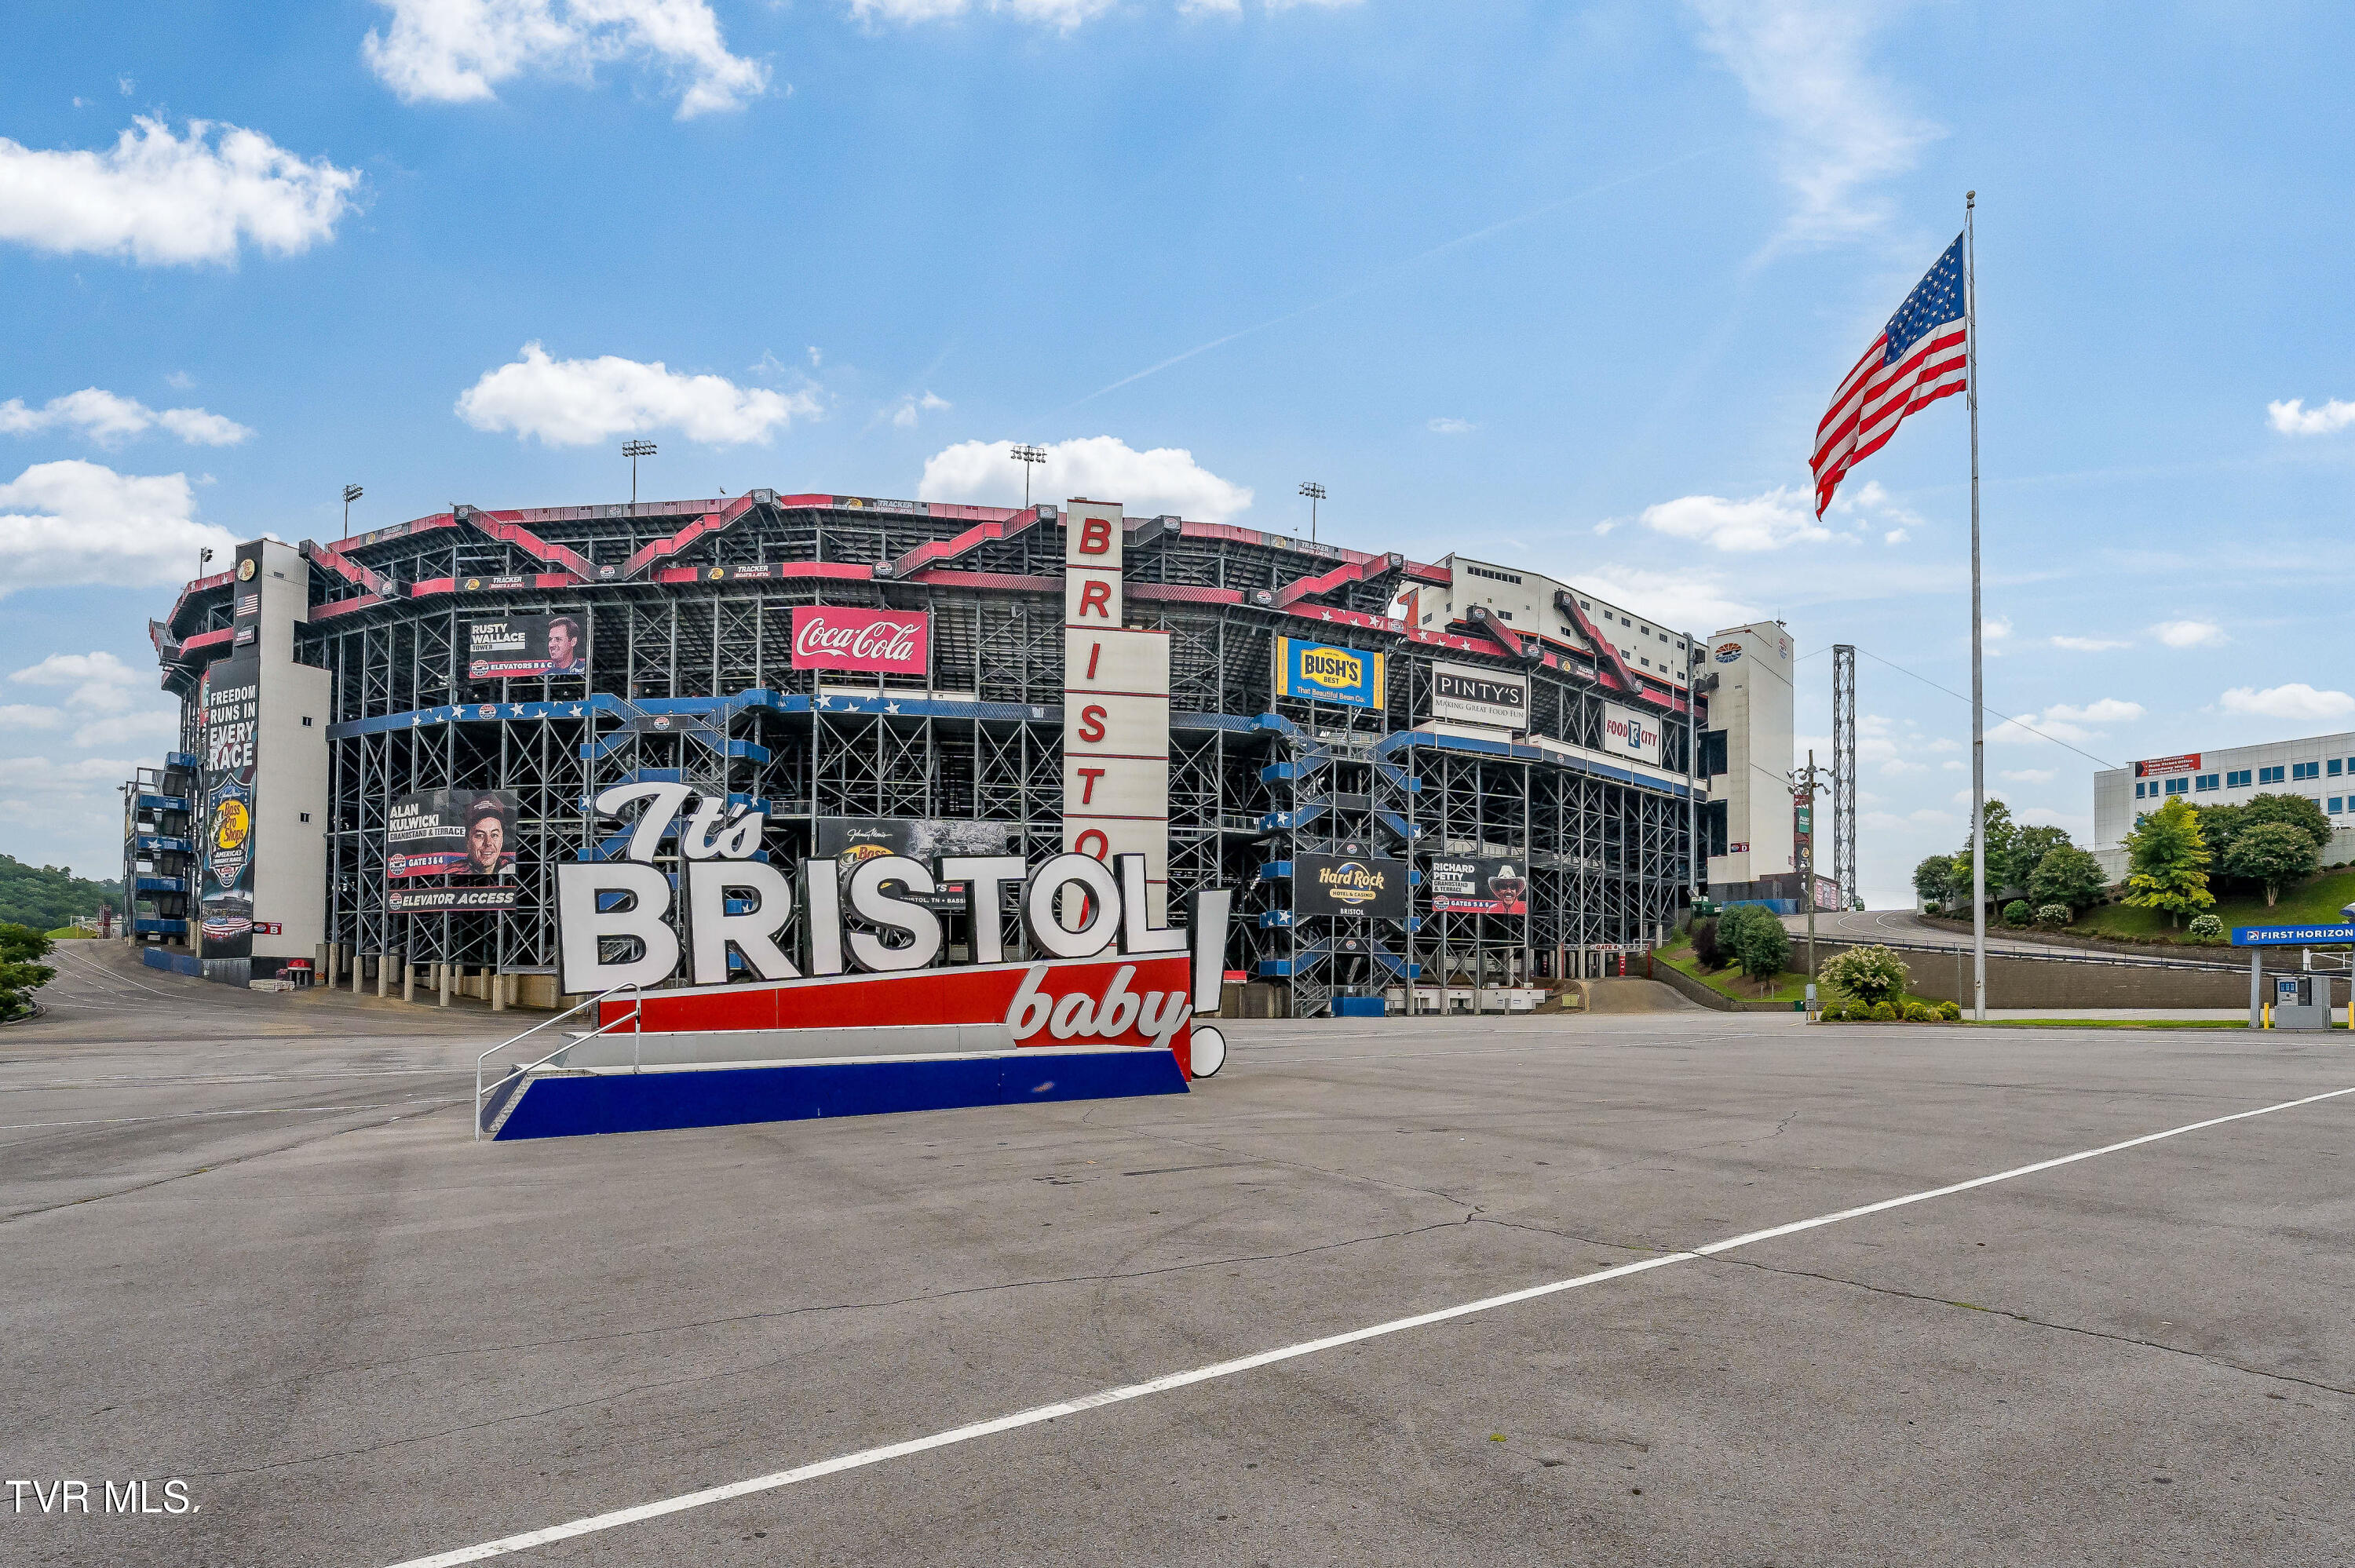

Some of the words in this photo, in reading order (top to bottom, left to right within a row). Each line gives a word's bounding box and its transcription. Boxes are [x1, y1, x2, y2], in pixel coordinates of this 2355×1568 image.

[472, 623, 508, 634] RUSTY
[472, 632, 526, 644] WALLACE
[796, 617, 922, 661] Coca-Cola
[1305, 654, 1358, 682] BUSH'S
[1324, 676, 1339, 684] BEST
[210, 684, 256, 706] FREEDOM
[1297, 686, 1311, 695] That
[1312, 688, 1338, 698] Beautiful
[1339, 692, 1354, 701] Bean
[210, 705, 240, 724] RUNS
[243, 701, 256, 719] IN
[1075, 517, 1112, 929] BRISTO
[210, 720, 255, 746] EVERY
[1607, 720, 1628, 738] FOOD
[1641, 730, 1658, 747] CITY
[209, 742, 253, 771] RACE
[224, 802, 240, 817] Bass
[389, 803, 419, 819] ALAN
[223, 817, 237, 829] Pro
[389, 814, 440, 832] KULWICKI
[594, 782, 765, 864] It's
[224, 828, 244, 844] Shops
[390, 830, 427, 841] GRANDSTAND
[434, 827, 465, 837] TERRACE
[408, 859, 427, 867] GATE
[1433, 862, 1475, 873] RICHARD
[1319, 868, 1353, 885] Hard
[1353, 870, 1385, 889] Rock
[1433, 872, 1464, 881] PETTY
[402, 893, 455, 906] ELEVATOR
[457, 892, 515, 904] ACCESS
[1340, 907, 1364, 916] BRISTOL
[554, 852, 1188, 994] BRISTOL
[2261, 931, 2294, 939] FIRST
[2296, 929, 2353, 939] HORIZON
[1006, 965, 1194, 1048] baby
